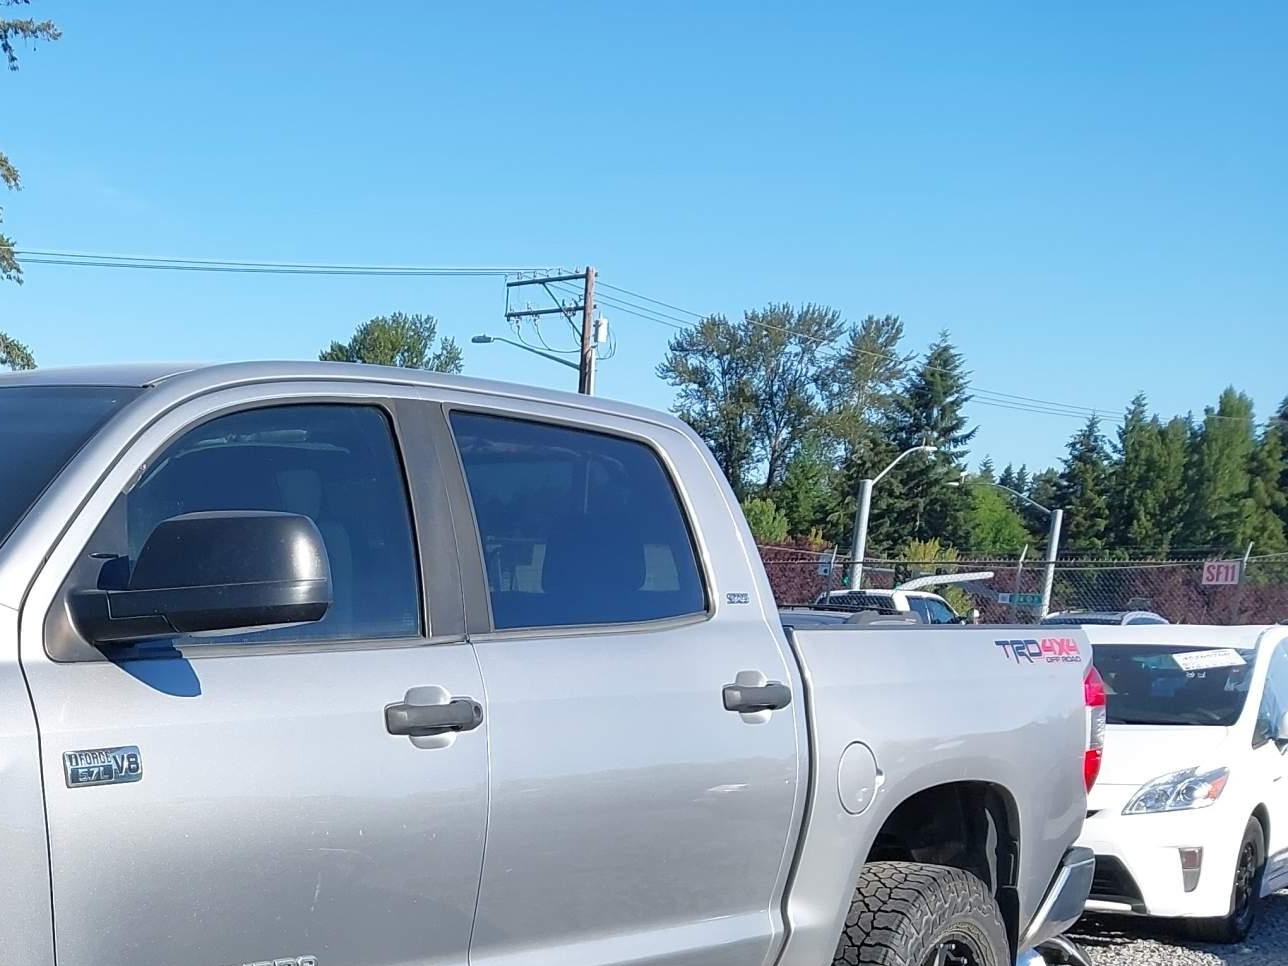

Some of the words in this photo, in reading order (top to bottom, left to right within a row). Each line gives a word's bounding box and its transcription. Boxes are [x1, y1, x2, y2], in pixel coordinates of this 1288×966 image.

[1206, 564, 1236, 582] SF11
[994, 639, 1043, 664] TRD
[1045, 655, 1061, 664] OFF
[1061, 655, 1082, 663] ROAD
[112, 753, 140, 776] V8
